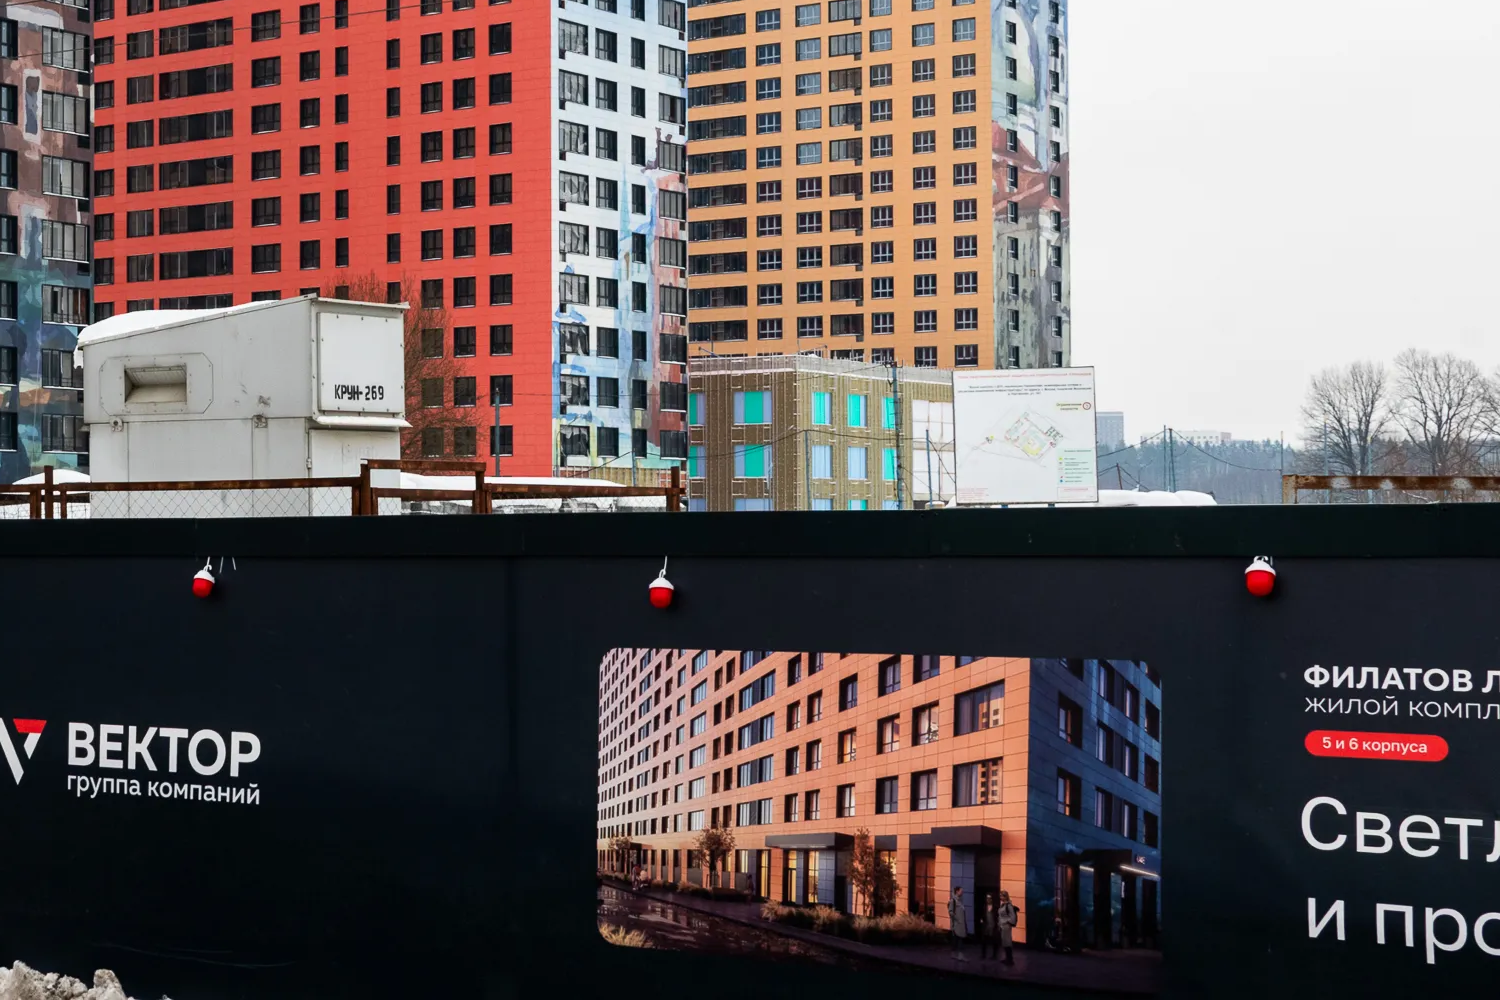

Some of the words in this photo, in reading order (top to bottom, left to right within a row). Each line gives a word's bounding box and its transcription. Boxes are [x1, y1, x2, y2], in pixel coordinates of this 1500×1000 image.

[1303, 664, 1474, 692] ФИЛАТОВ
[67, 722, 261, 777] ВЕКТОР
[1322, 736, 1332, 749] 5
[1335, 739, 1345, 750] и
[1349, 738, 1359, 750] 6
[1362, 741, 1428, 755] корпуса
[67, 775, 141, 798] группа
[148, 781, 260, 805] компаний
[1307, 897, 1346, 941] и
[1376, 903, 1500, 965] про
